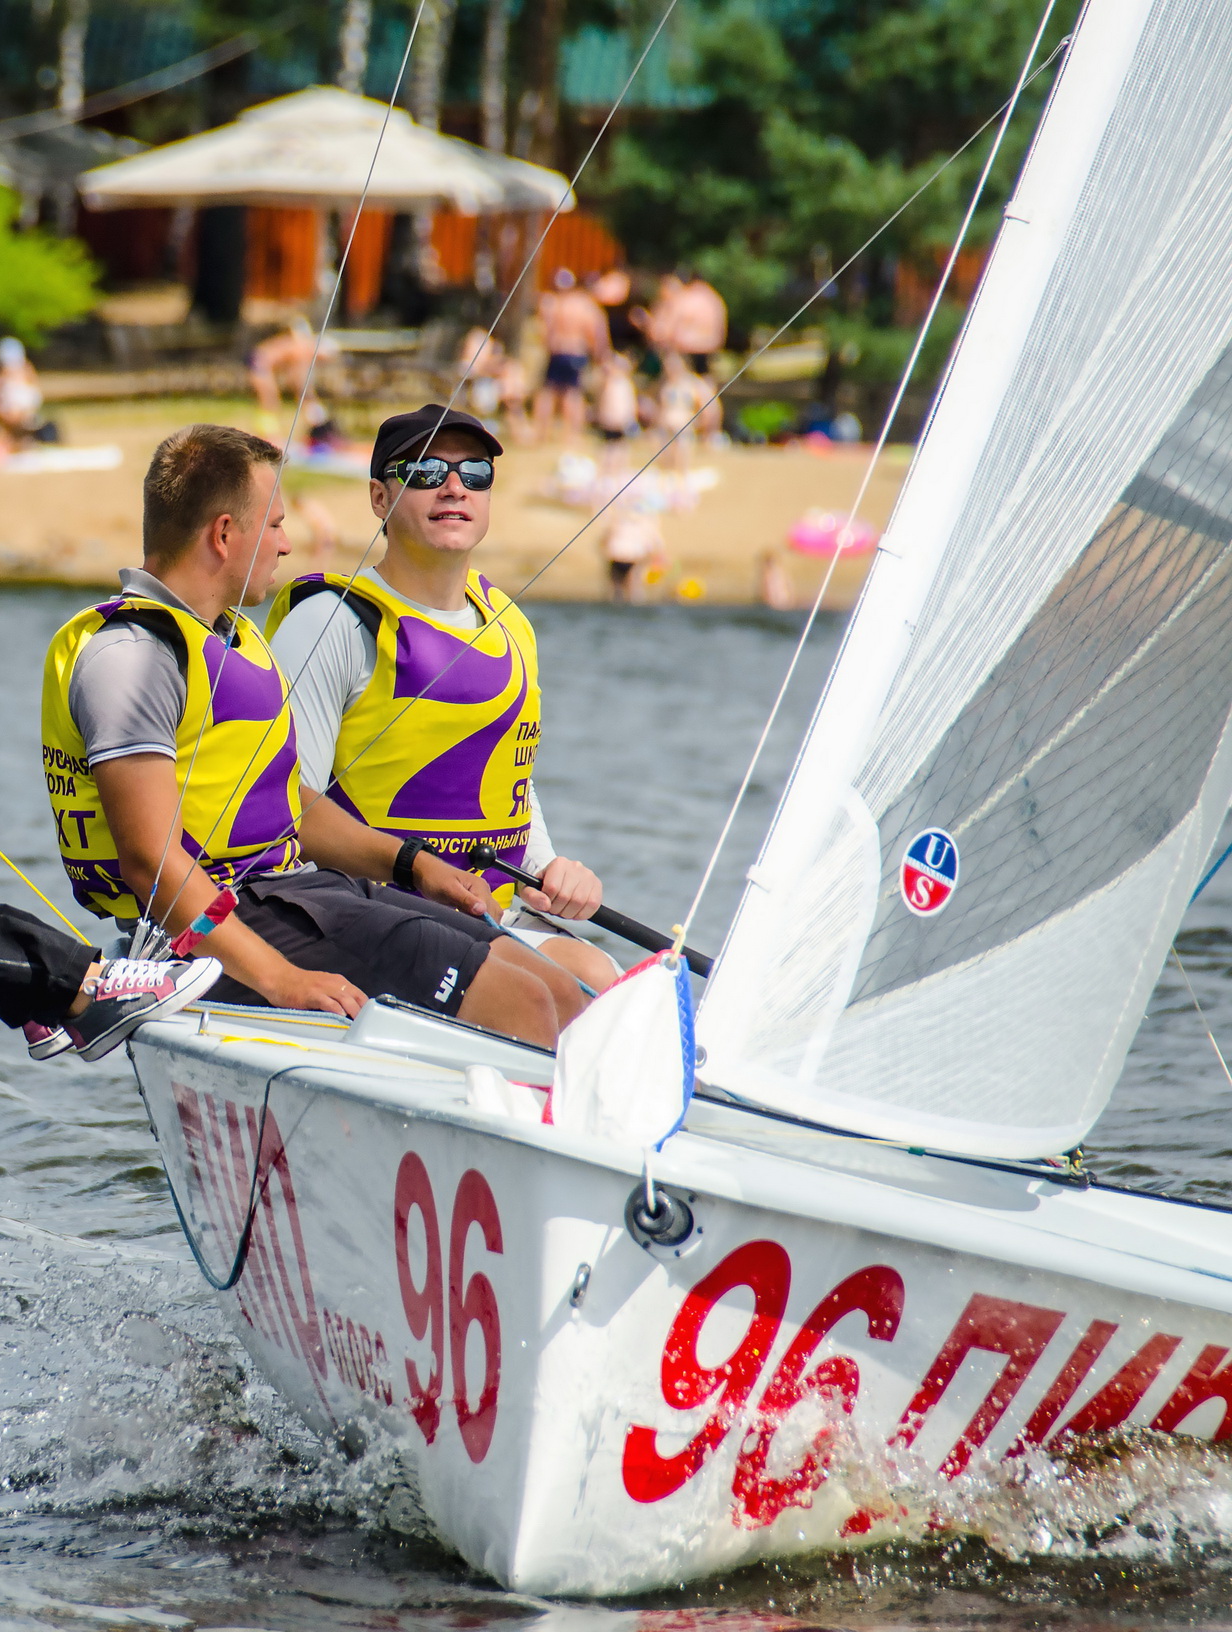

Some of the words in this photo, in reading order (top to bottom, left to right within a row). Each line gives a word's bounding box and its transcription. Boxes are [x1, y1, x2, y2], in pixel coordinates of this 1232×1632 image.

[52, 806, 97, 849] ХТ
[925, 833, 953, 869] U
[910, 875, 935, 909] S
[394, 1150, 503, 1464] 96
[622, 1239, 906, 1531] 96
